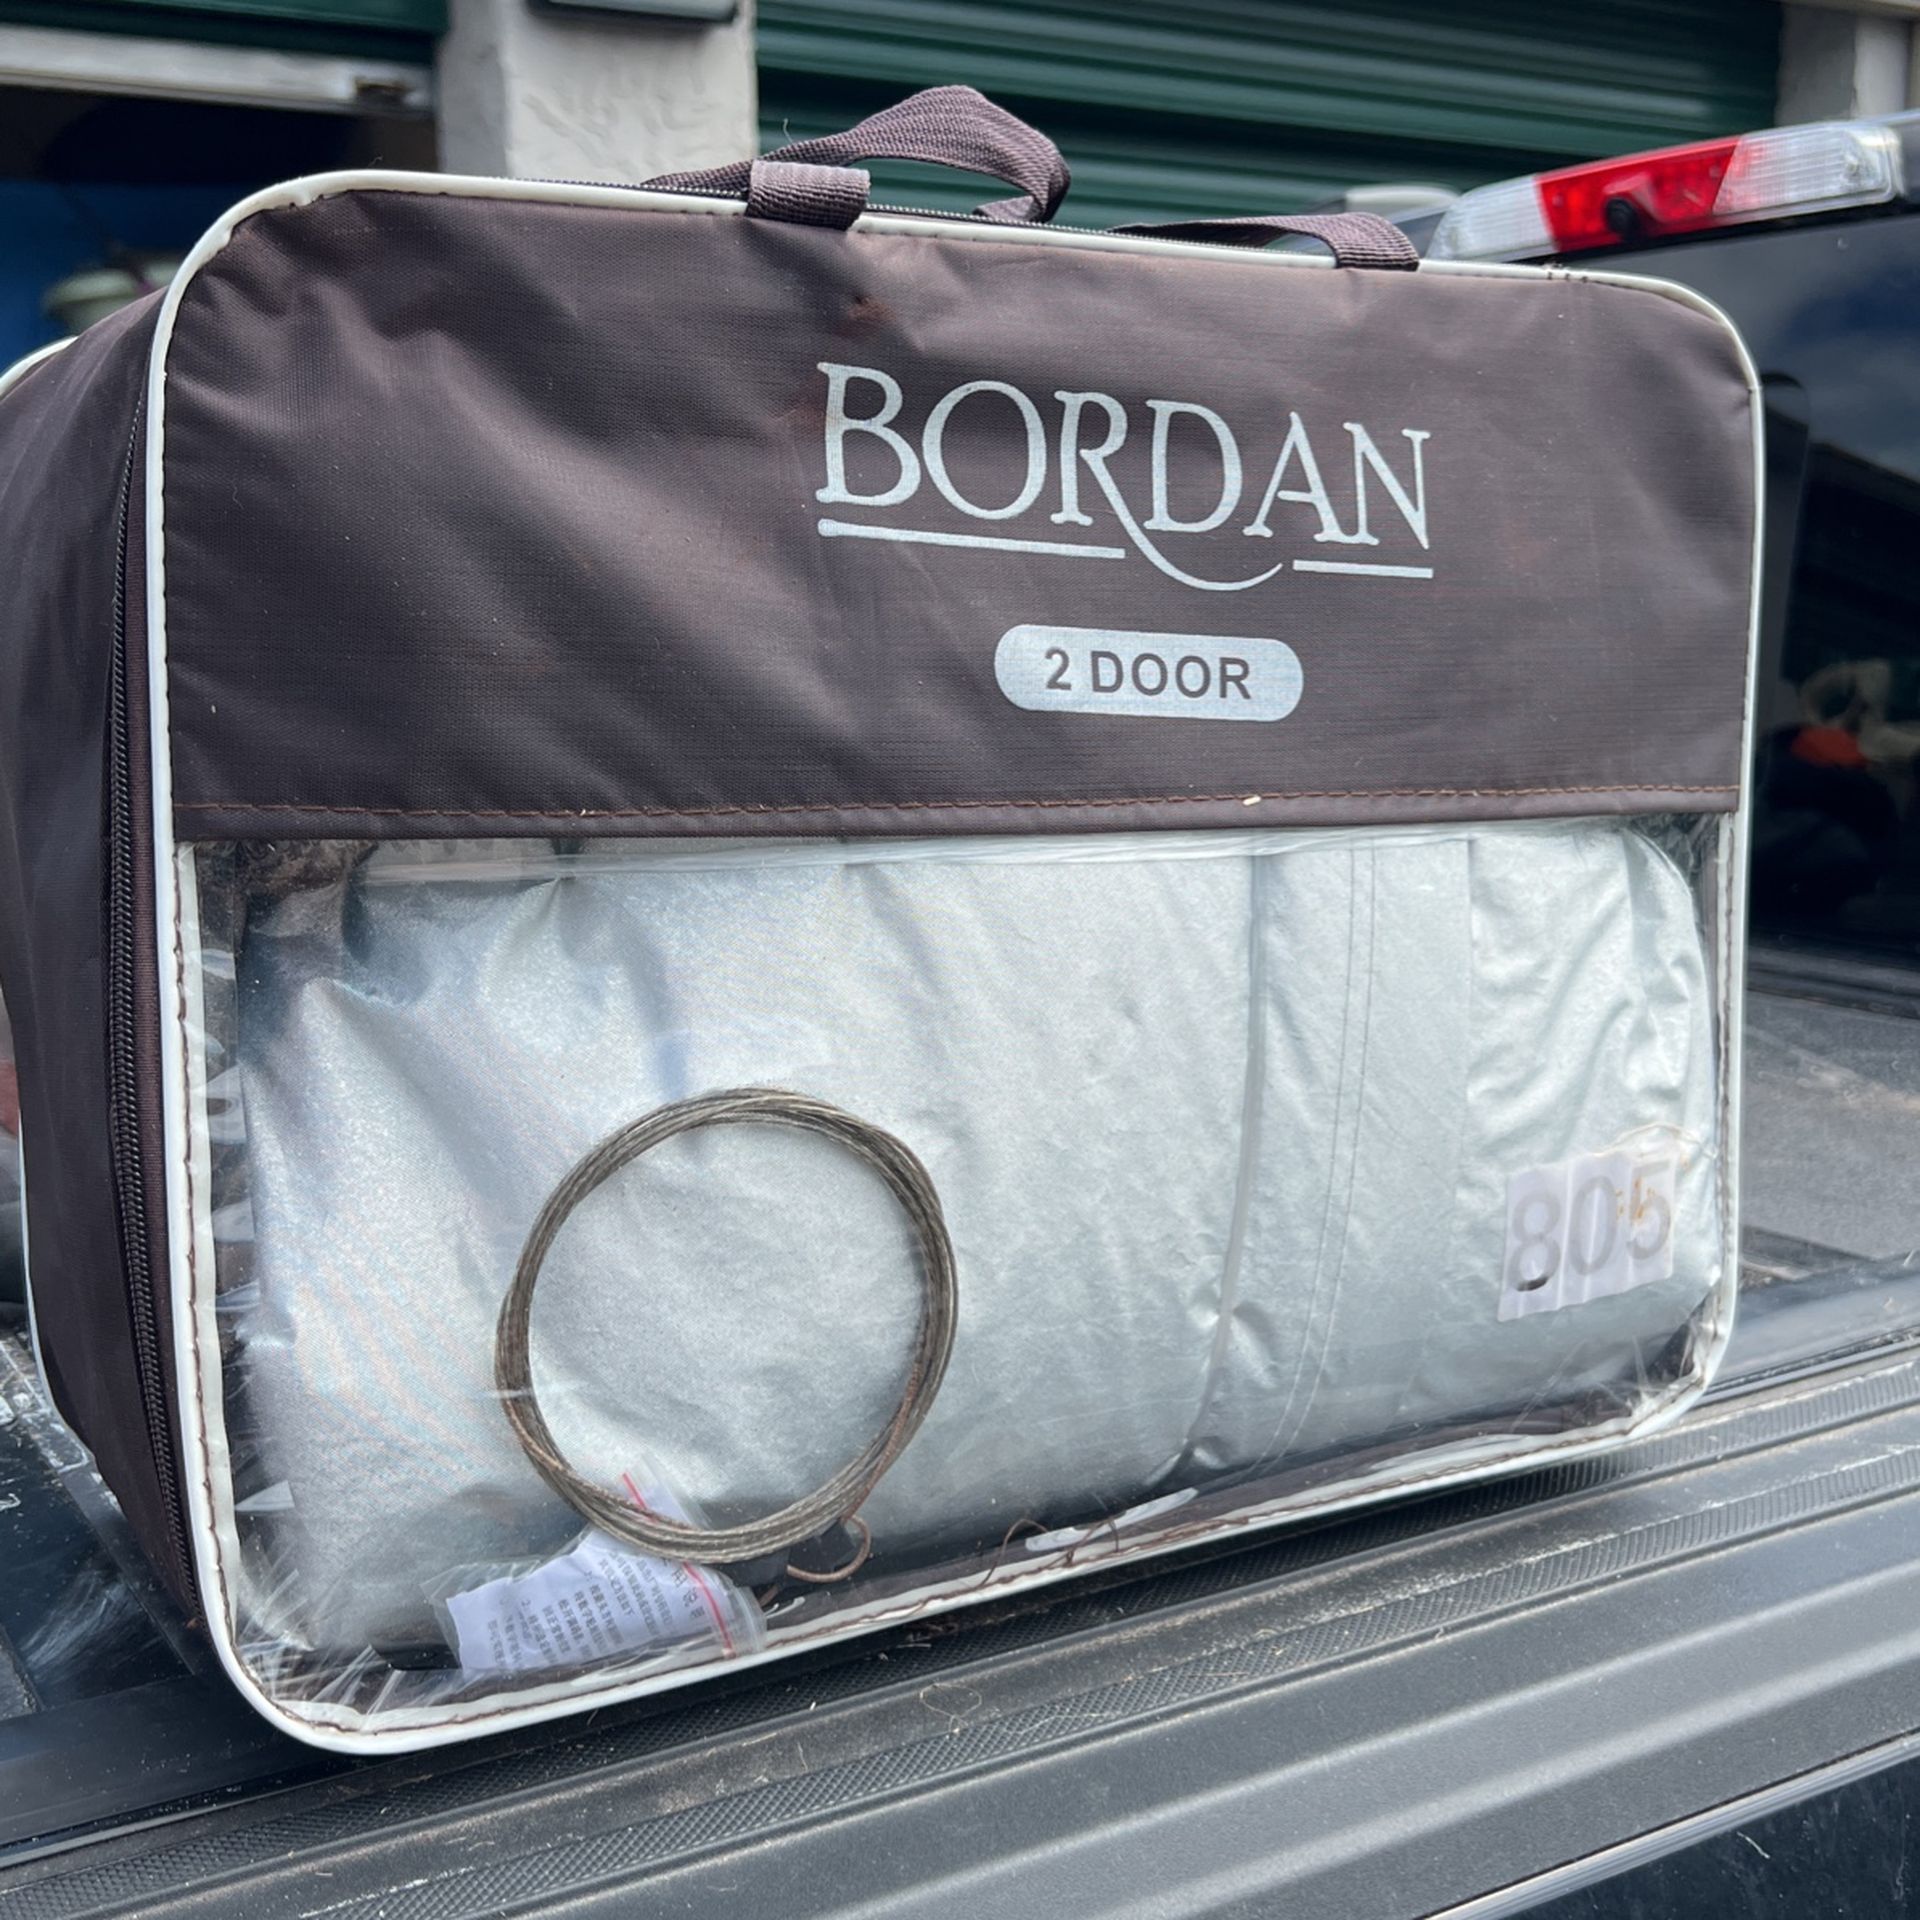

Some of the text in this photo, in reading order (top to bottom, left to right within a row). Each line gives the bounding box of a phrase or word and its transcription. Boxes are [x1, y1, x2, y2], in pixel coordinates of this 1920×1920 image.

[815, 361, 1432, 591] BORDAN
[1043, 647, 1252, 701] 2 DOOR
[1506, 1159, 1672, 1293] 805
